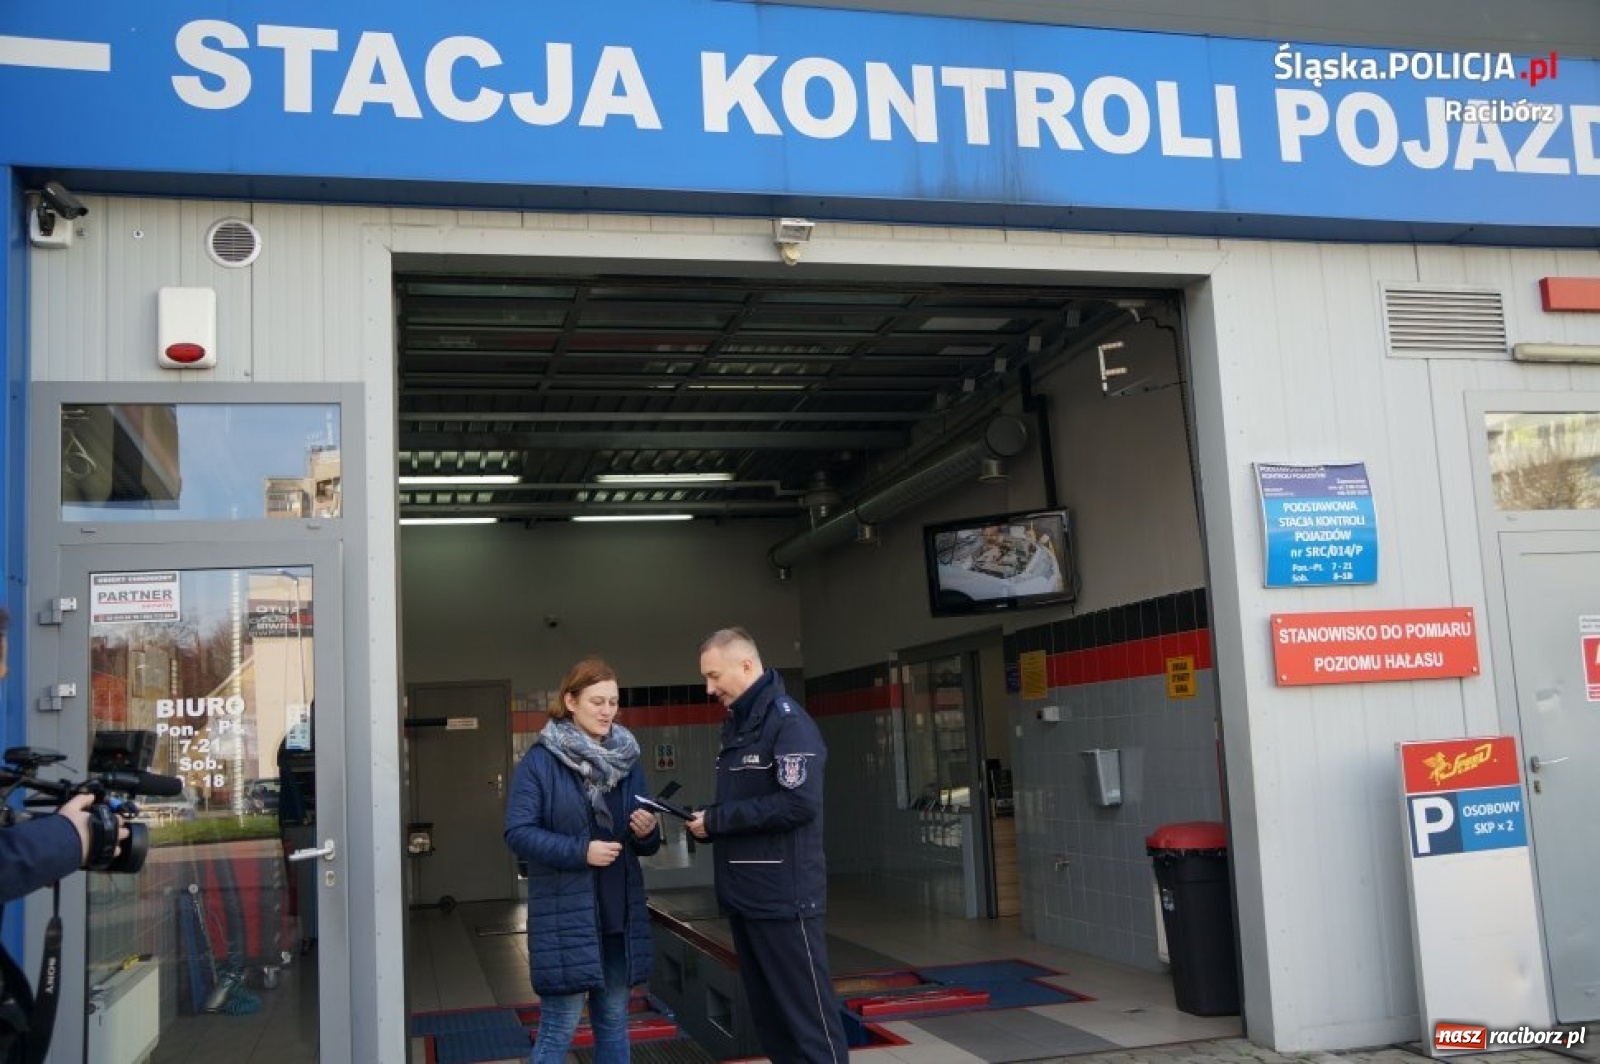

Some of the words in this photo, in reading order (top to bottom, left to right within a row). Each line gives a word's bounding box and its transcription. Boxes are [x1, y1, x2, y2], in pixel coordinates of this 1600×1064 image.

[171, 19, 662, 130] STACJA
[701, 52, 1242, 160] KONTROLI
[1283, 501, 1358, 512] PODSTAWOWA
[1279, 516, 1314, 527] STACJA
[1316, 515, 1365, 526] KONTROLI
[1295, 528, 1352, 541] POJAZDÓW
[1290, 548, 1303, 558] nr
[98, 589, 172, 601] PARTNER
[1279, 624, 1377, 644] STANOWISKO
[1381, 624, 1403, 640] DO
[1406, 622, 1471, 639] POMIARU
[1314, 655, 1381, 672] POZIOMU
[1385, 652, 1443, 669] HAŁASU
[156, 697, 245, 718] BIURO
[156, 723, 199, 737] Pon.
[179, 755, 223, 771] Sob.
[203, 774, 225, 788] 18
[1463, 801, 1520, 817] OSOBOWY
[1411, 797, 1454, 854] P
[1474, 822, 1495, 835] SKP
[1506, 820, 1514, 831] 2
